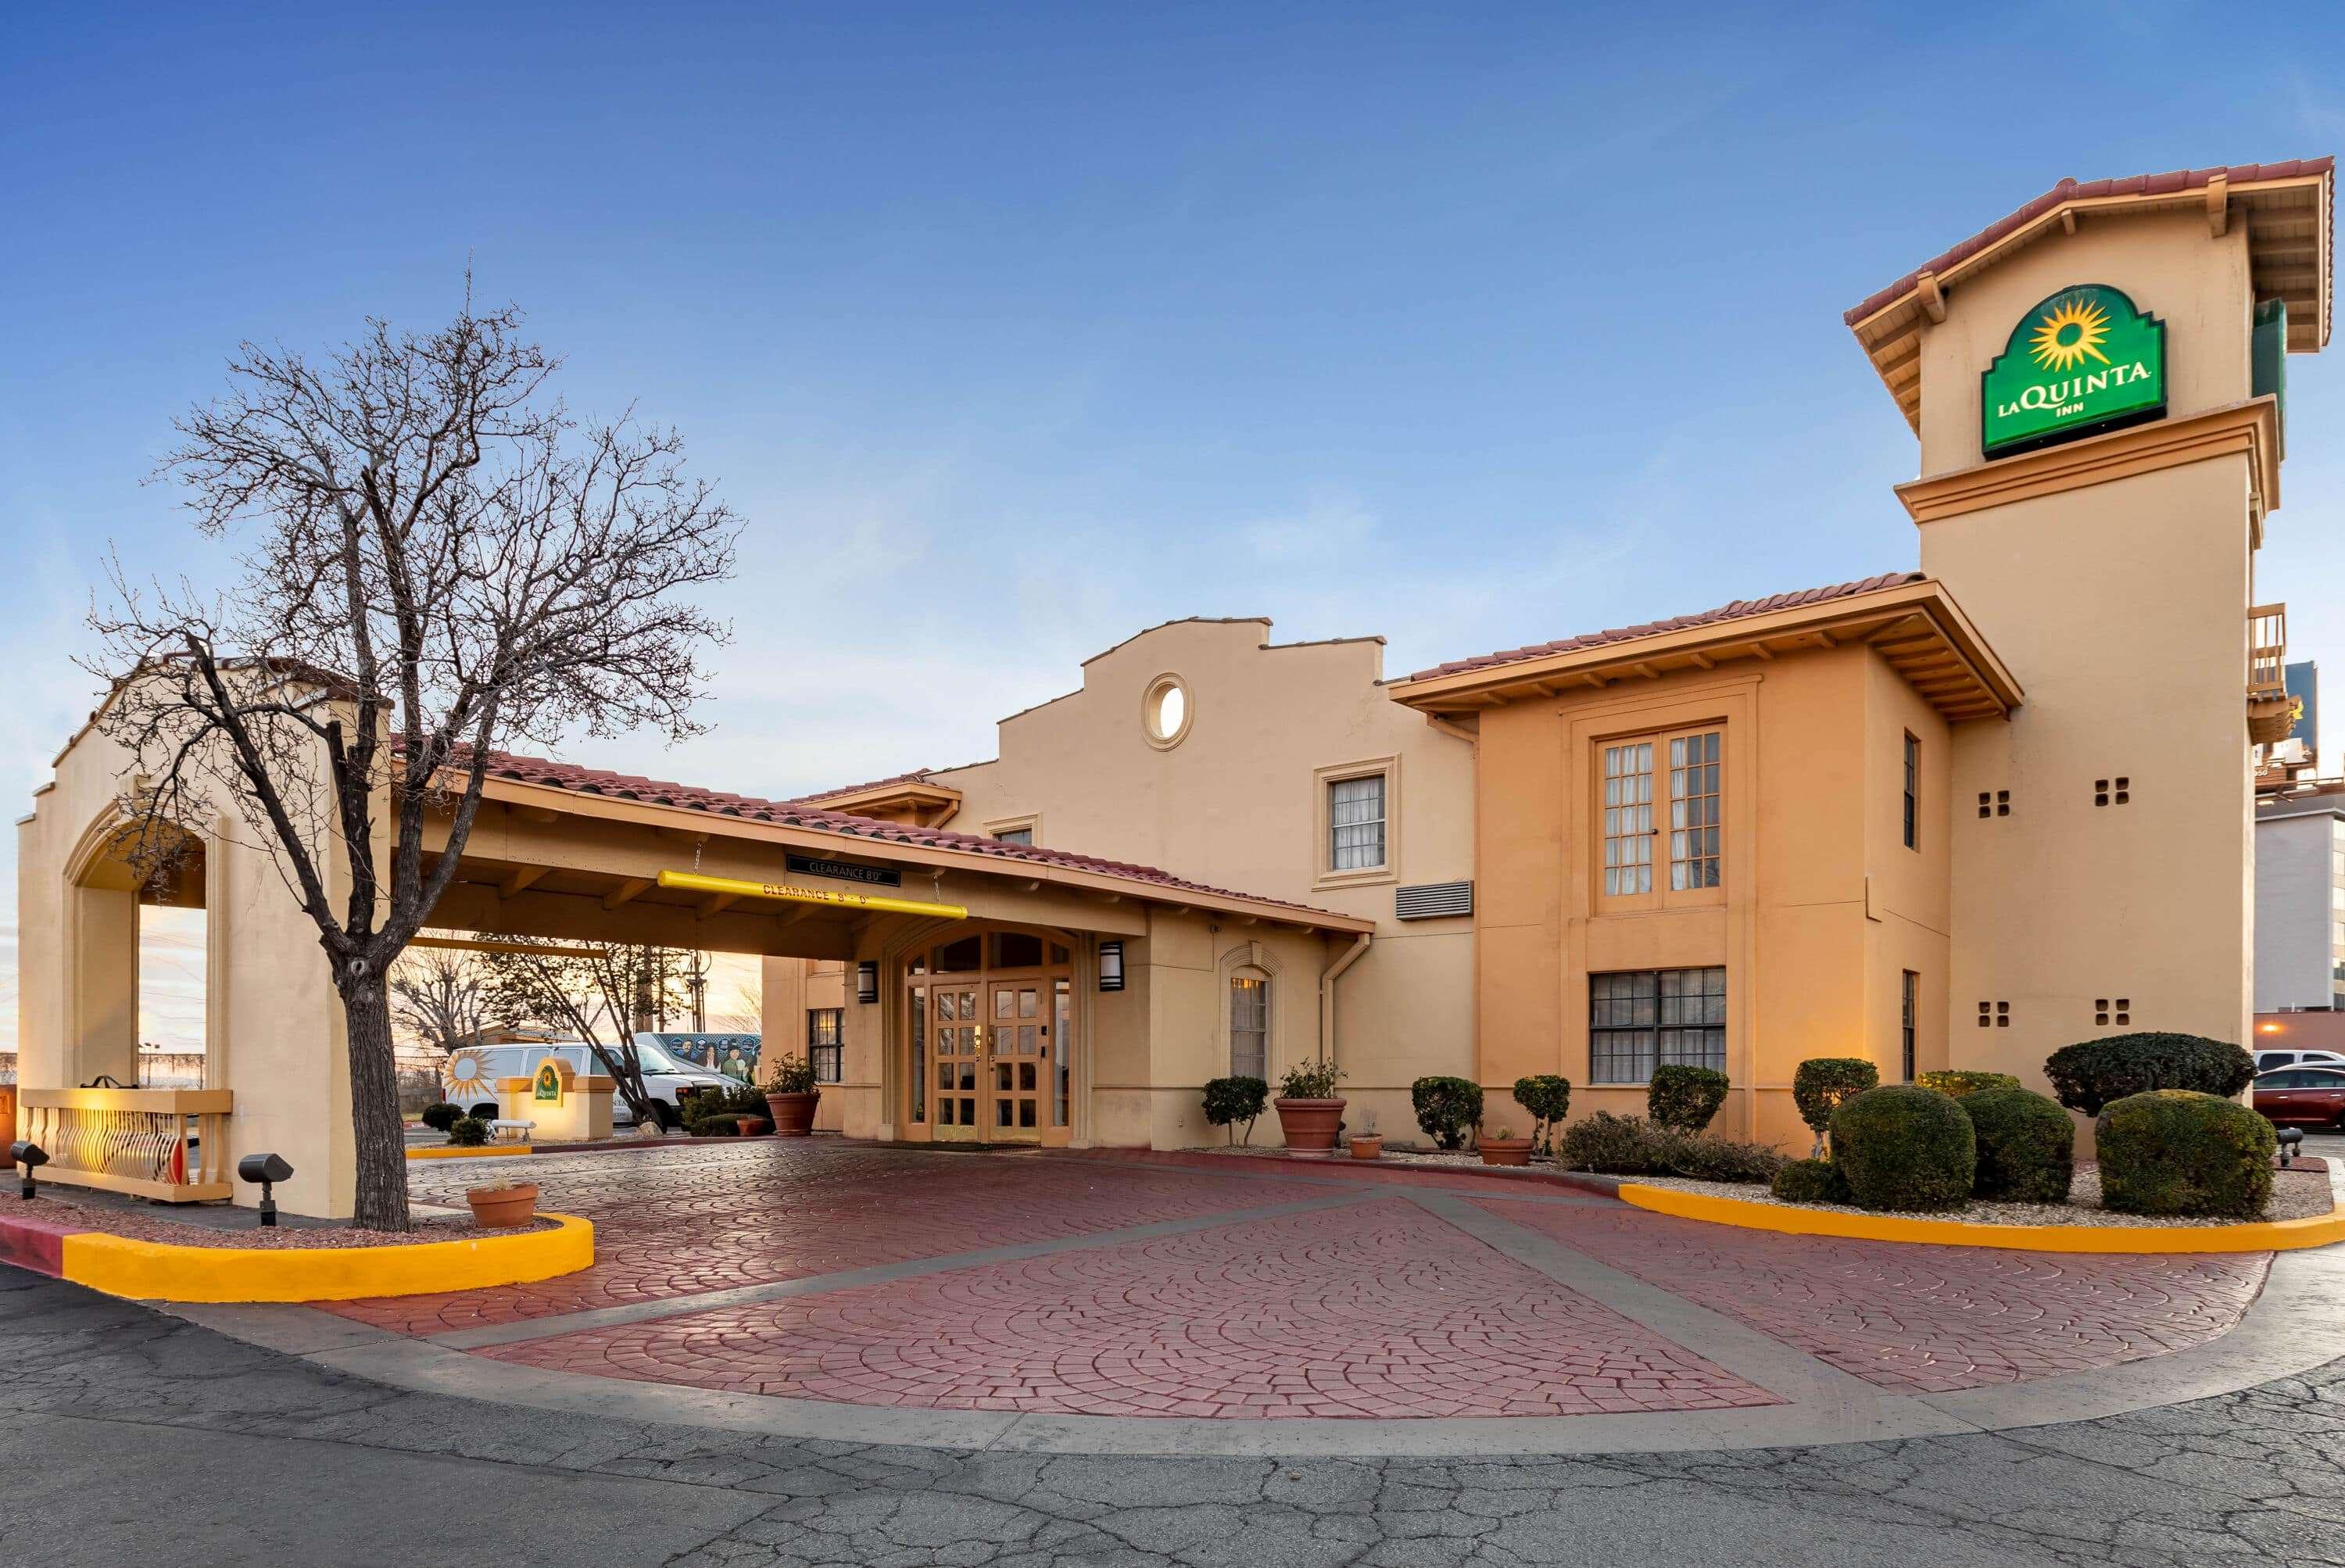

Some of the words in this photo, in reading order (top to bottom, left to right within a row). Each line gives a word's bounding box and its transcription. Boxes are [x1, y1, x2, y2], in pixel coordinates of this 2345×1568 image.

[1998, 401, 2021, 417] LA
[2020, 361, 2151, 410] QUINTA
[2056, 402, 2084, 417] INN
[809, 861, 864, 879] CLEARANCE
[763, 884, 829, 900] CLEARANCE
